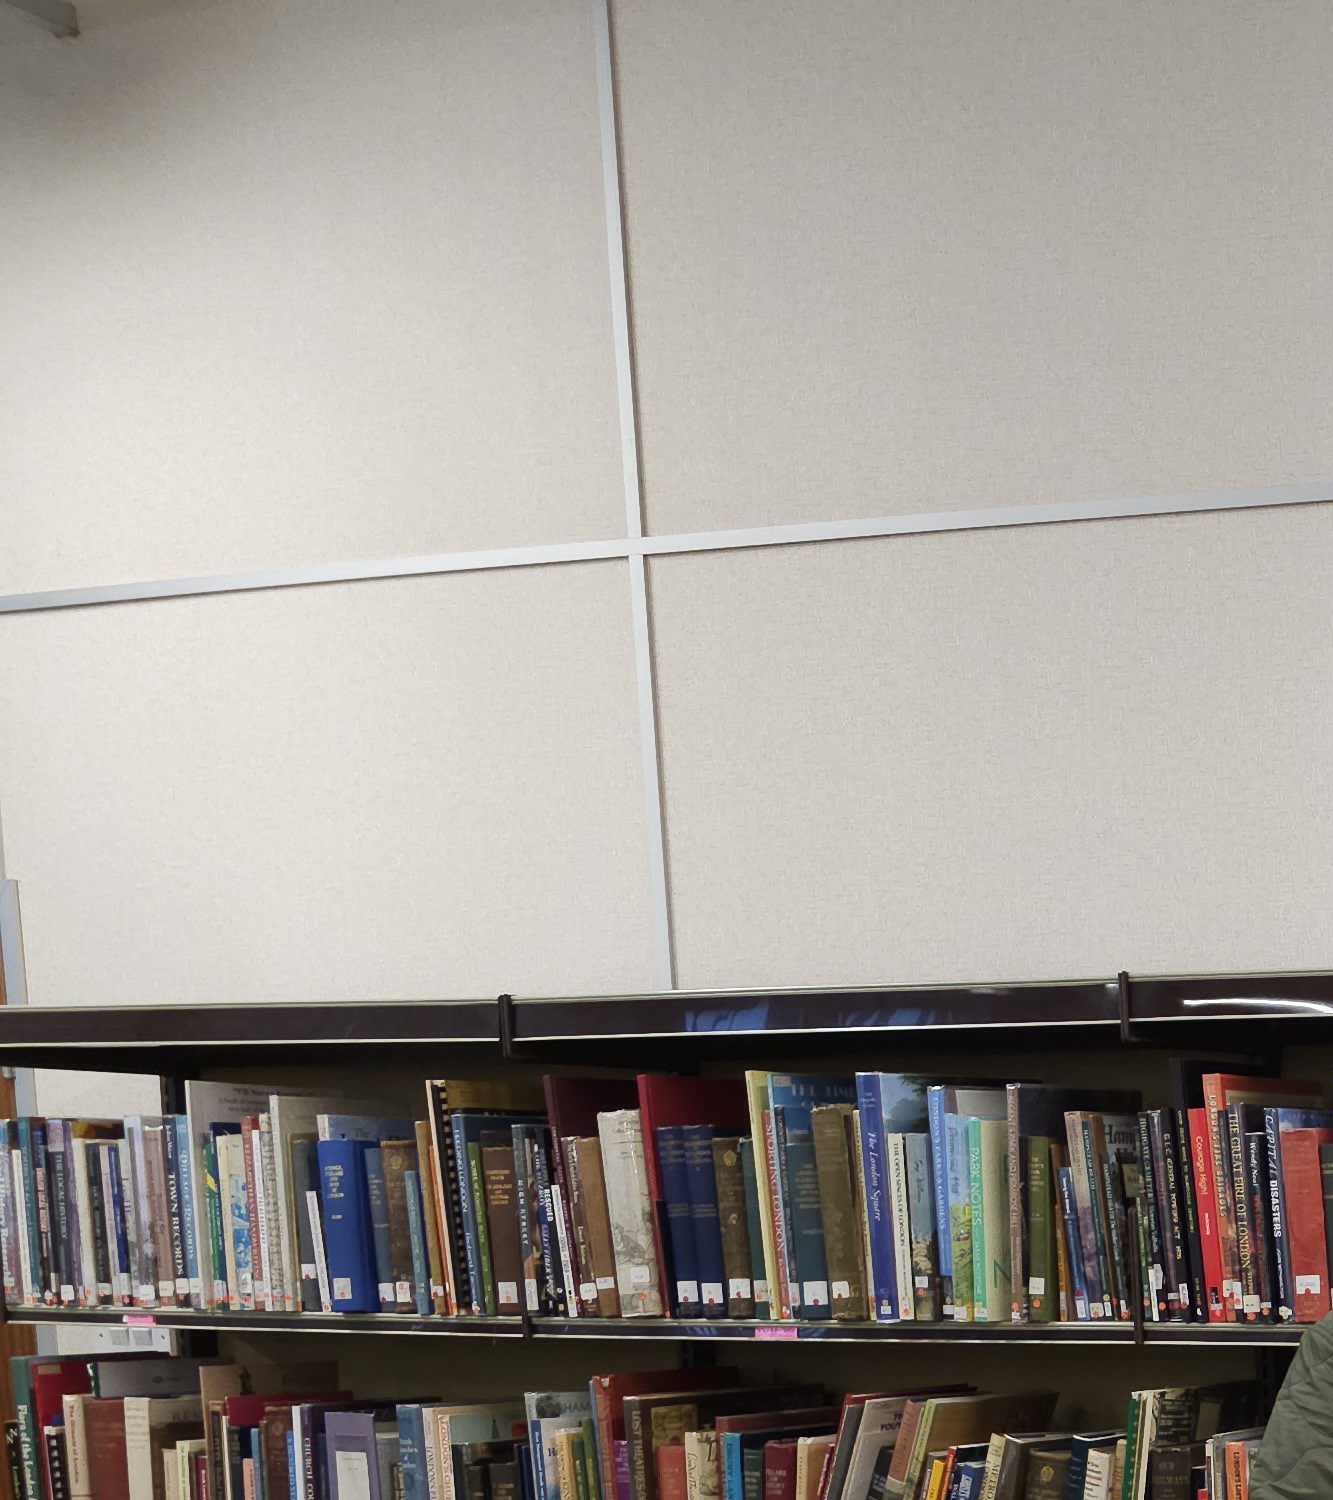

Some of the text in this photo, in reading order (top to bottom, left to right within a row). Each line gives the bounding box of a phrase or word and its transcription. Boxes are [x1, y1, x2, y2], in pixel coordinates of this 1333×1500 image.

[971, 1147, 982, 1225] PARK NOTES
[1265, 1114, 1281, 1238] CAPITAL DISASTERS
